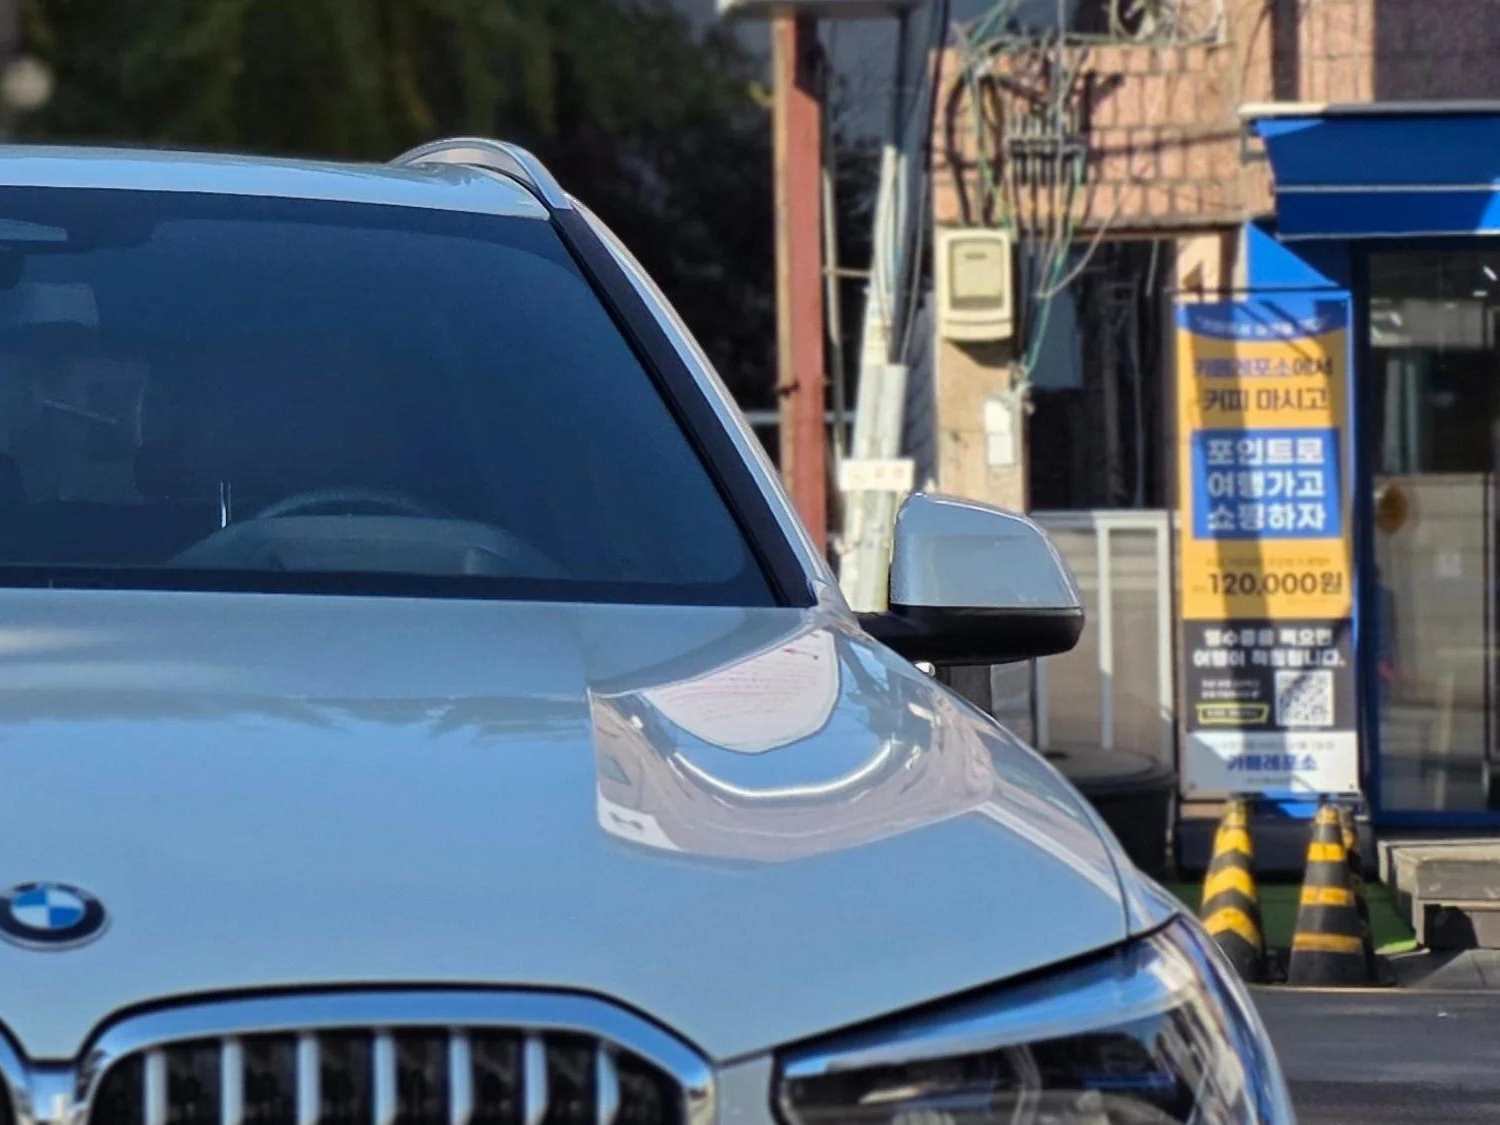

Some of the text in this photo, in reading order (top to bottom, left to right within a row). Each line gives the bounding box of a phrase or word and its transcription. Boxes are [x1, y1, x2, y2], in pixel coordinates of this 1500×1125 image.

[1204, 387, 1328, 412] 커피 마시고
[1207, 437, 1325, 466] 포인트로
[1208, 470, 1325, 499] 여행가고
[1208, 502, 1327, 531] 쇼핑하자
